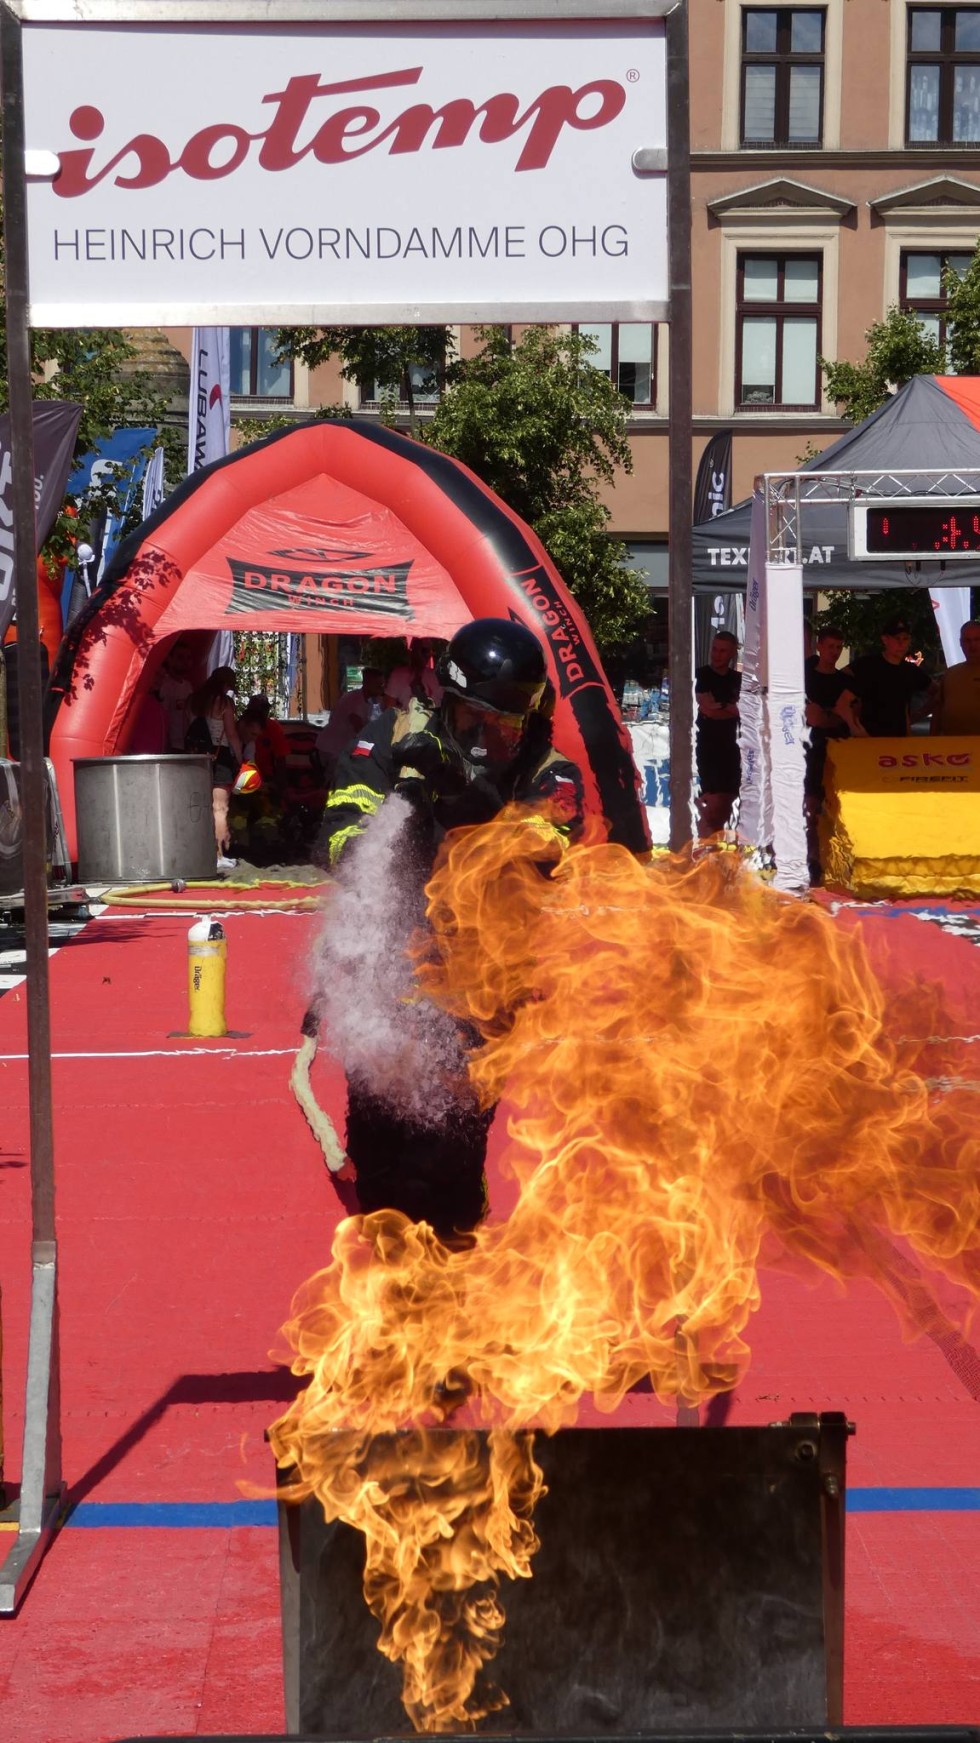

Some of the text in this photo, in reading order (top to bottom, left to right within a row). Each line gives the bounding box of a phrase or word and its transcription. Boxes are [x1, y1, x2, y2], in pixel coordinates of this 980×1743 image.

[52, 66, 626, 198] isotemp
[54, 225, 629, 260] HEINRICH VORNDAMME OHG
[244, 571, 395, 593] DRAGON
[521, 578, 584, 682] DRAGON
[554, 601, 580, 645] WINCH
